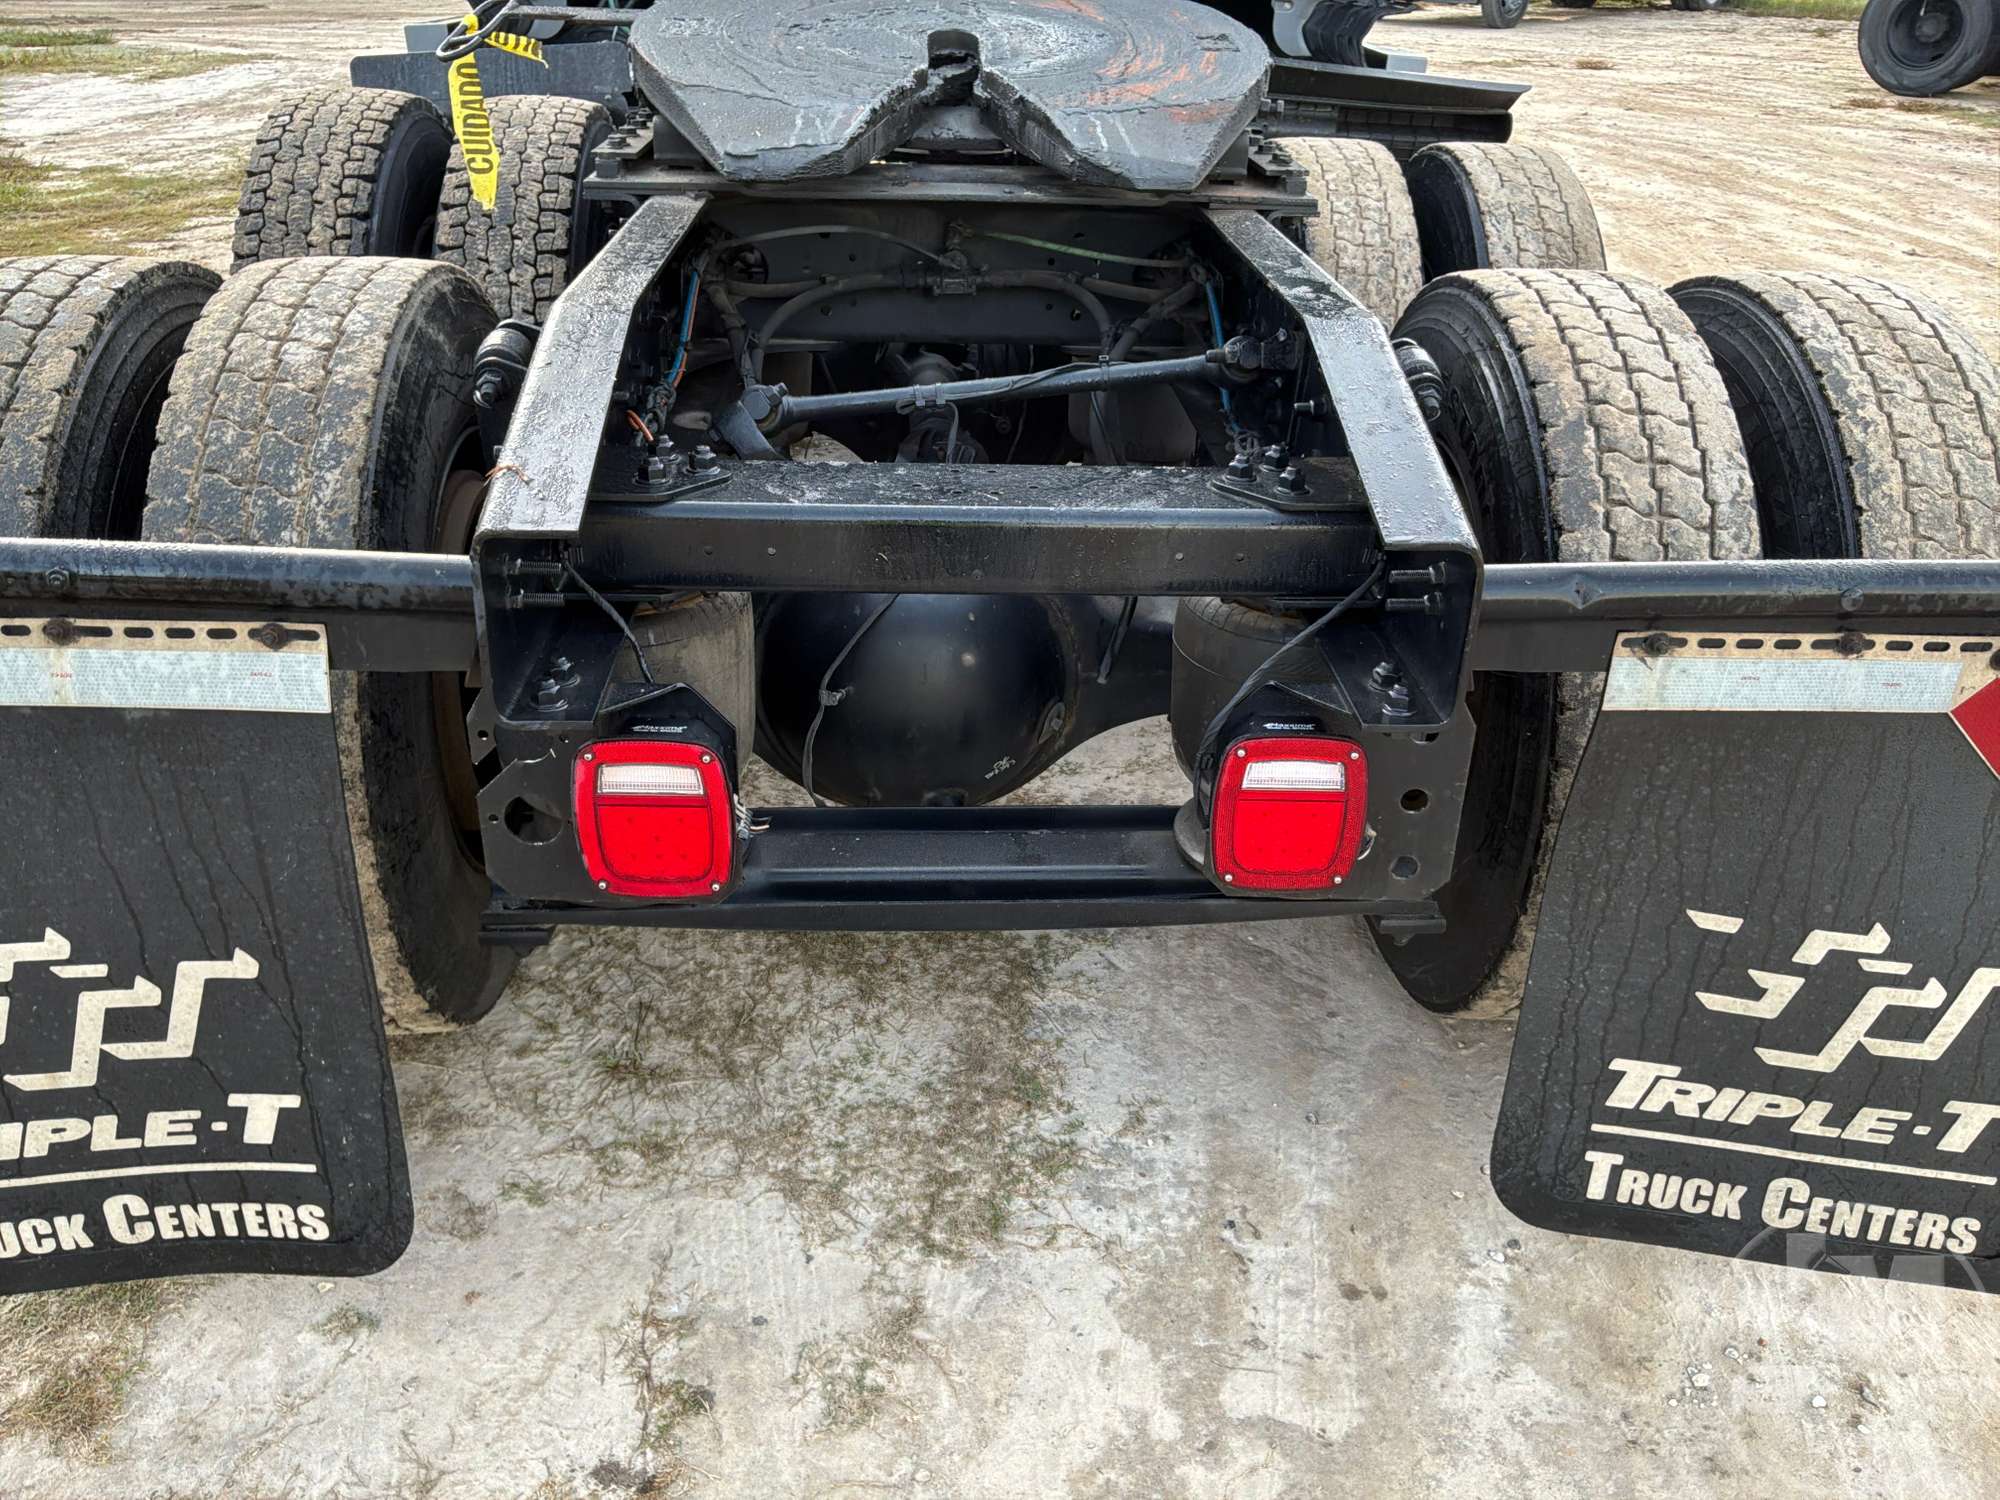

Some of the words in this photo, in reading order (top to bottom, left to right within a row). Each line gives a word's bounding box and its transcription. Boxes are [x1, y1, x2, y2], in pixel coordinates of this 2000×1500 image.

[456, 62, 495, 175] CUIDADO
[1604, 1057, 2000, 1154] TRIPLE-T
[102, 1194, 330, 1245] CENTERS
[1584, 1150, 1748, 1221] TRUCK
[1761, 1177, 1982, 1255] CENTERS
